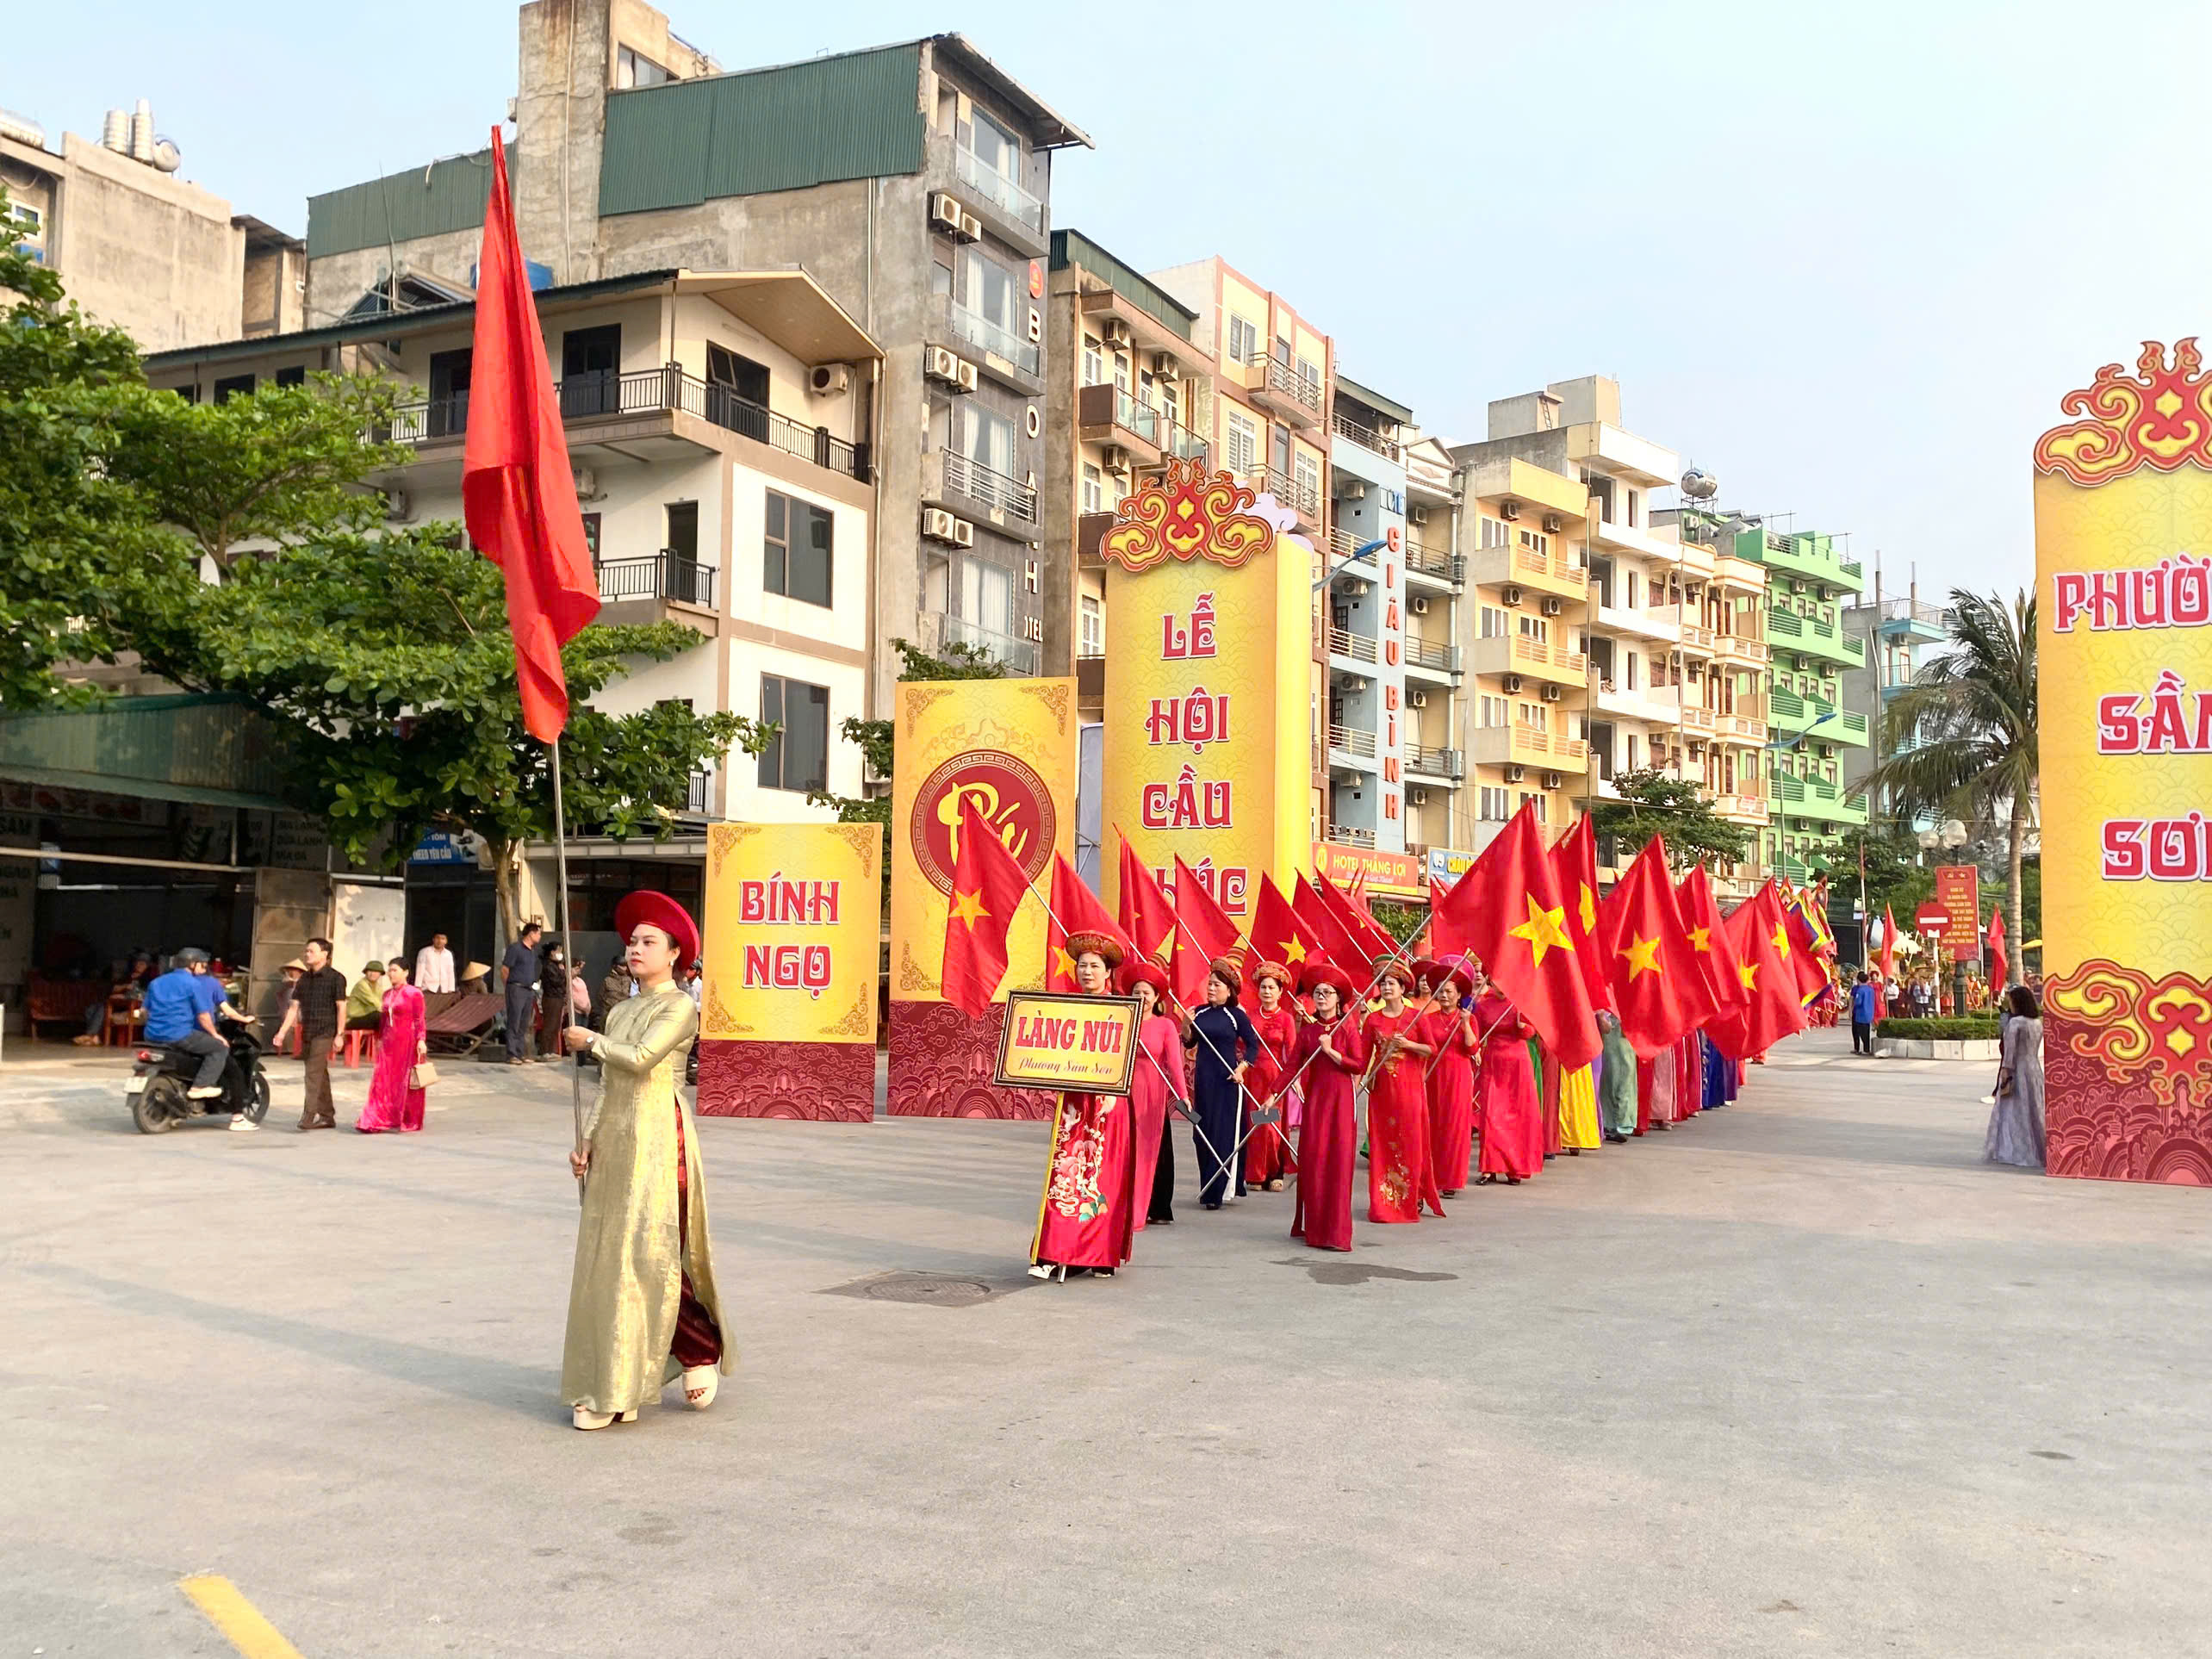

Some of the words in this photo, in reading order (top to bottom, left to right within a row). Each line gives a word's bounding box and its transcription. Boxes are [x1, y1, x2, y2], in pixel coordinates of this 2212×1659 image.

[2056, 554, 2211, 629] PHƯỜ
[1163, 592, 1215, 658] LỄ
[1145, 687, 1228, 751] HỘI
[1143, 763, 1231, 827] CẦU
[1333, 854, 1358, 871] HOTEL
[2104, 812, 2211, 877] SƠ
[740, 870, 841, 922] BÍNH
[1155, 857, 1247, 913] ÚC
[744, 945, 832, 997] NGỌ
[1015, 1010, 1077, 1050] LÀNG
[1079, 1014, 1124, 1053] NÚI
